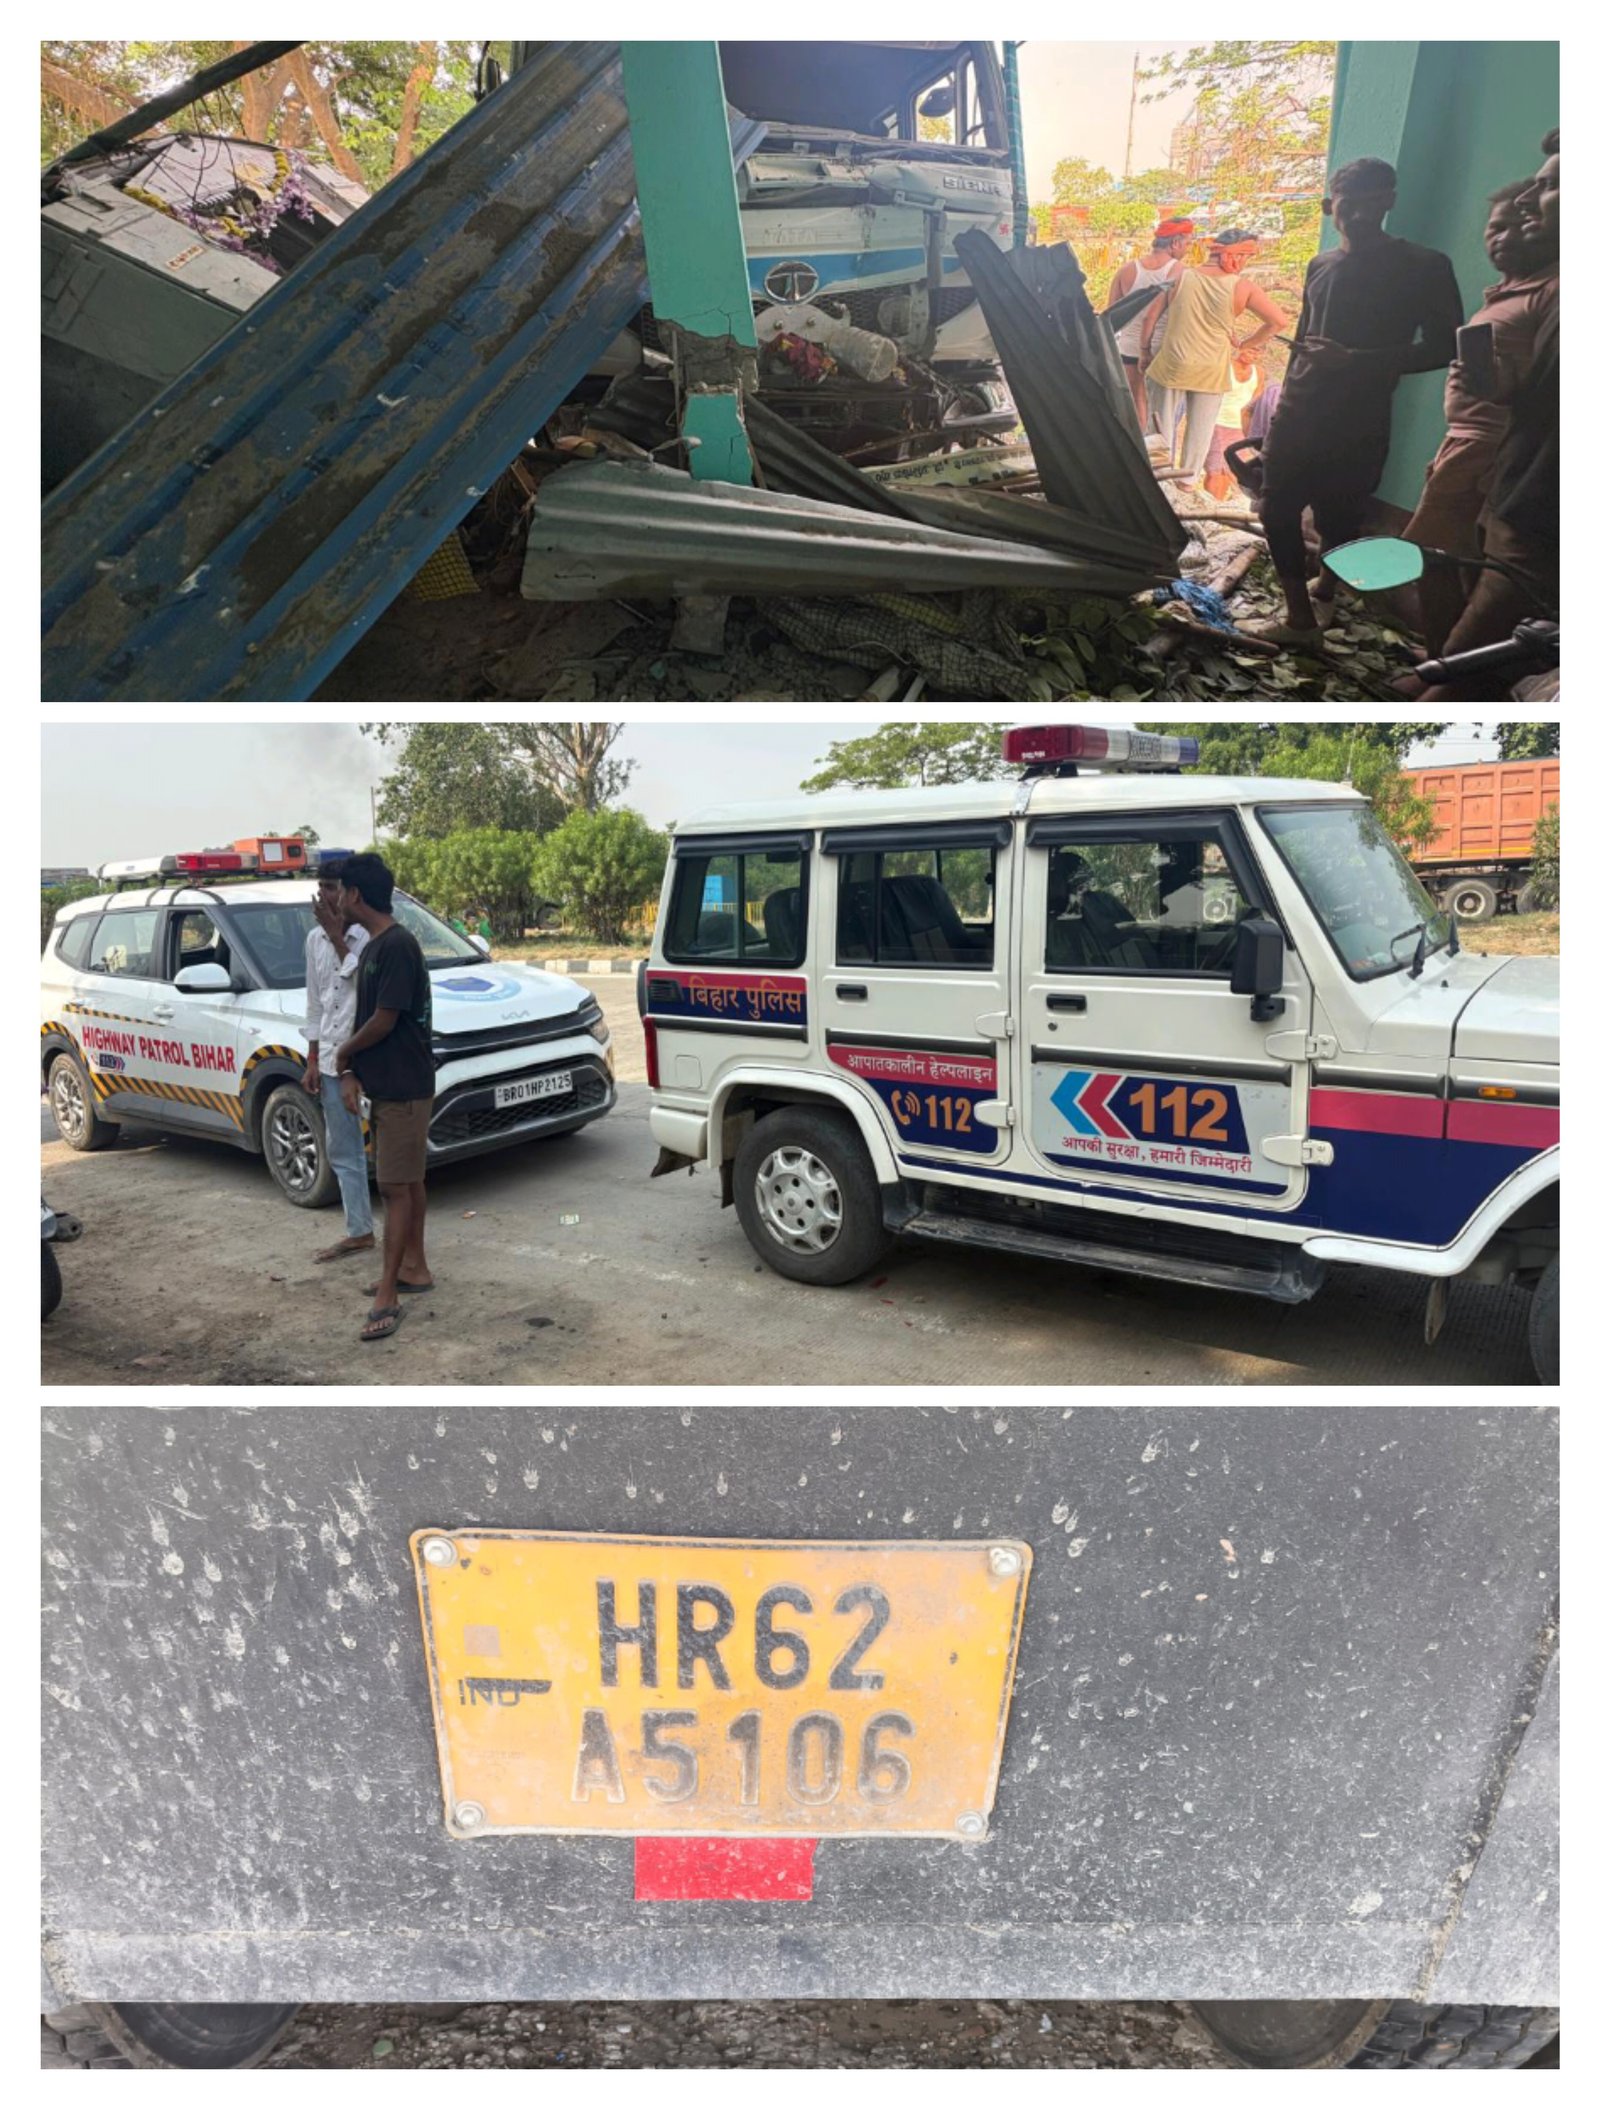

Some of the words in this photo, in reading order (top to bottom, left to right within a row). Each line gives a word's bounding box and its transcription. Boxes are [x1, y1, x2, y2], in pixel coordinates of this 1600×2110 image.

[688, 975, 740, 1012] बिहार
[745, 978, 801, 1019] पुलिस
[82, 1025, 136, 1057] HIGHWAY
[138, 1036, 191, 1067] PATROL
[190, 1043, 237, 1073] BIHAR
[848, 1054, 925, 1075] आपातकालीन
[929, 1056, 993, 1083] हेल्पलाइन
[503, 1073, 572, 1102] BR01HP2125
[924, 1094, 972, 1132] 112
[1129, 1083, 1228, 1142] 112
[1063, 1135, 1102, 1152] आपकी
[1150, 1144, 1186, 1165] हमारी
[1190, 1150, 1252, 1173] जिम्मेदारी
[596, 1580, 890, 1690] HR62
[458, 1678, 521, 1706] IND
[571, 1708, 915, 1804] A5106
